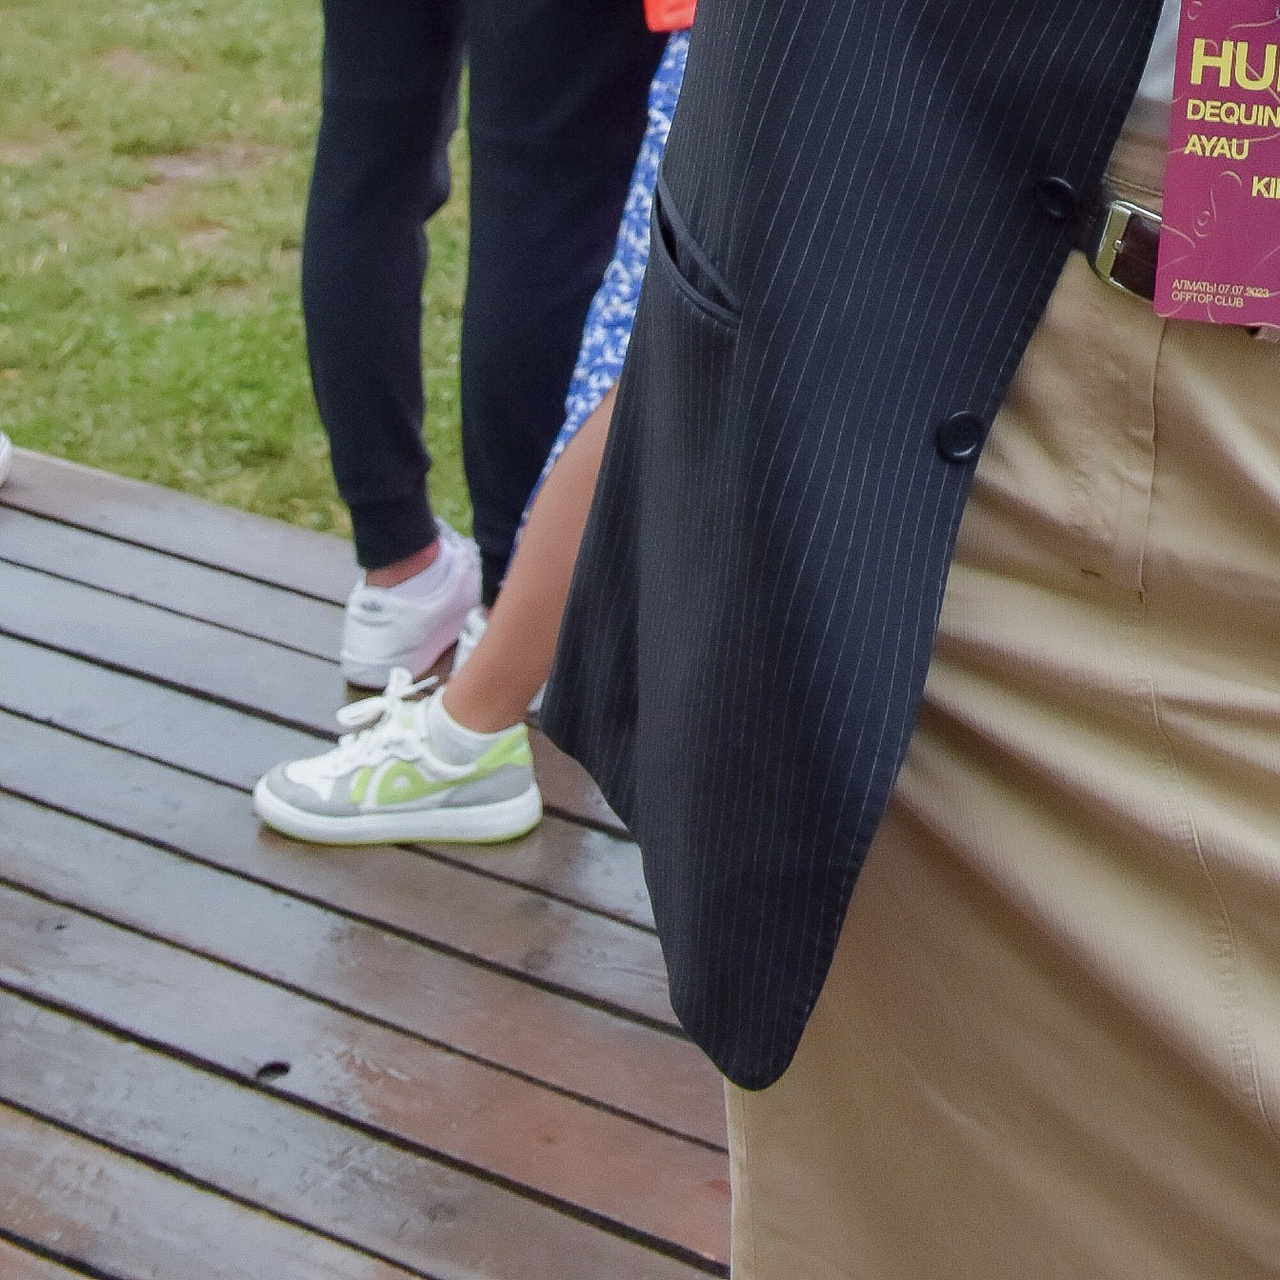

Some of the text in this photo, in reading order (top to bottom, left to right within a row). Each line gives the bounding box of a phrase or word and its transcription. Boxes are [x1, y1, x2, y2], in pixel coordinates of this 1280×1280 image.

[1184, 134, 1249, 160] AYAU
[1171, 278, 1217, 293] АЛМАТЫ
[1171, 290, 1244, 309] OFFTOP CLUB
